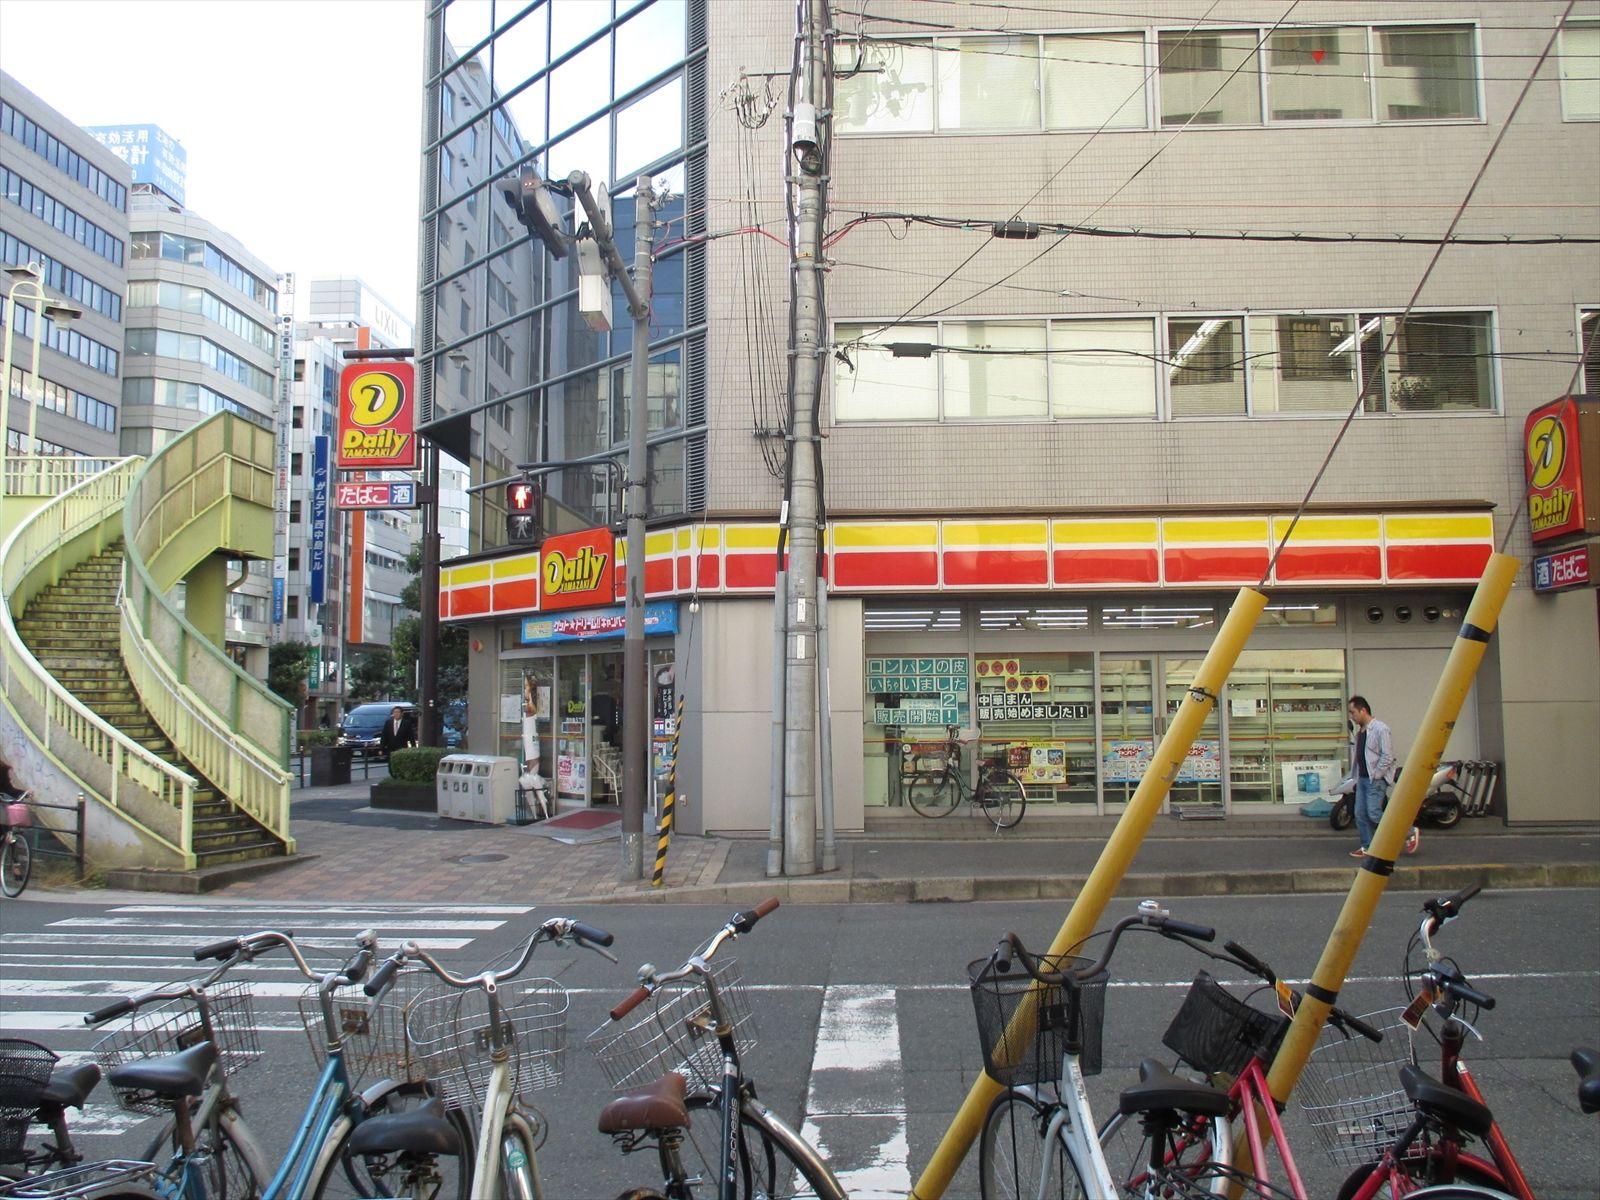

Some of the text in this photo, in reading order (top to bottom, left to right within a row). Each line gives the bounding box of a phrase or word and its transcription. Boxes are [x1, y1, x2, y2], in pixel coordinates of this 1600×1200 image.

[343, 448, 391, 458] YAMAZAKI
[344, 429, 410, 457] Daily
[340, 485, 411, 504] たばこ 酒
[1530, 486, 1575, 524] Daily
[543, 546, 608, 595] Daily
[1537, 554, 1588, 585] 酒 たばこ
[978, 694, 1031, 706] 中華まん
